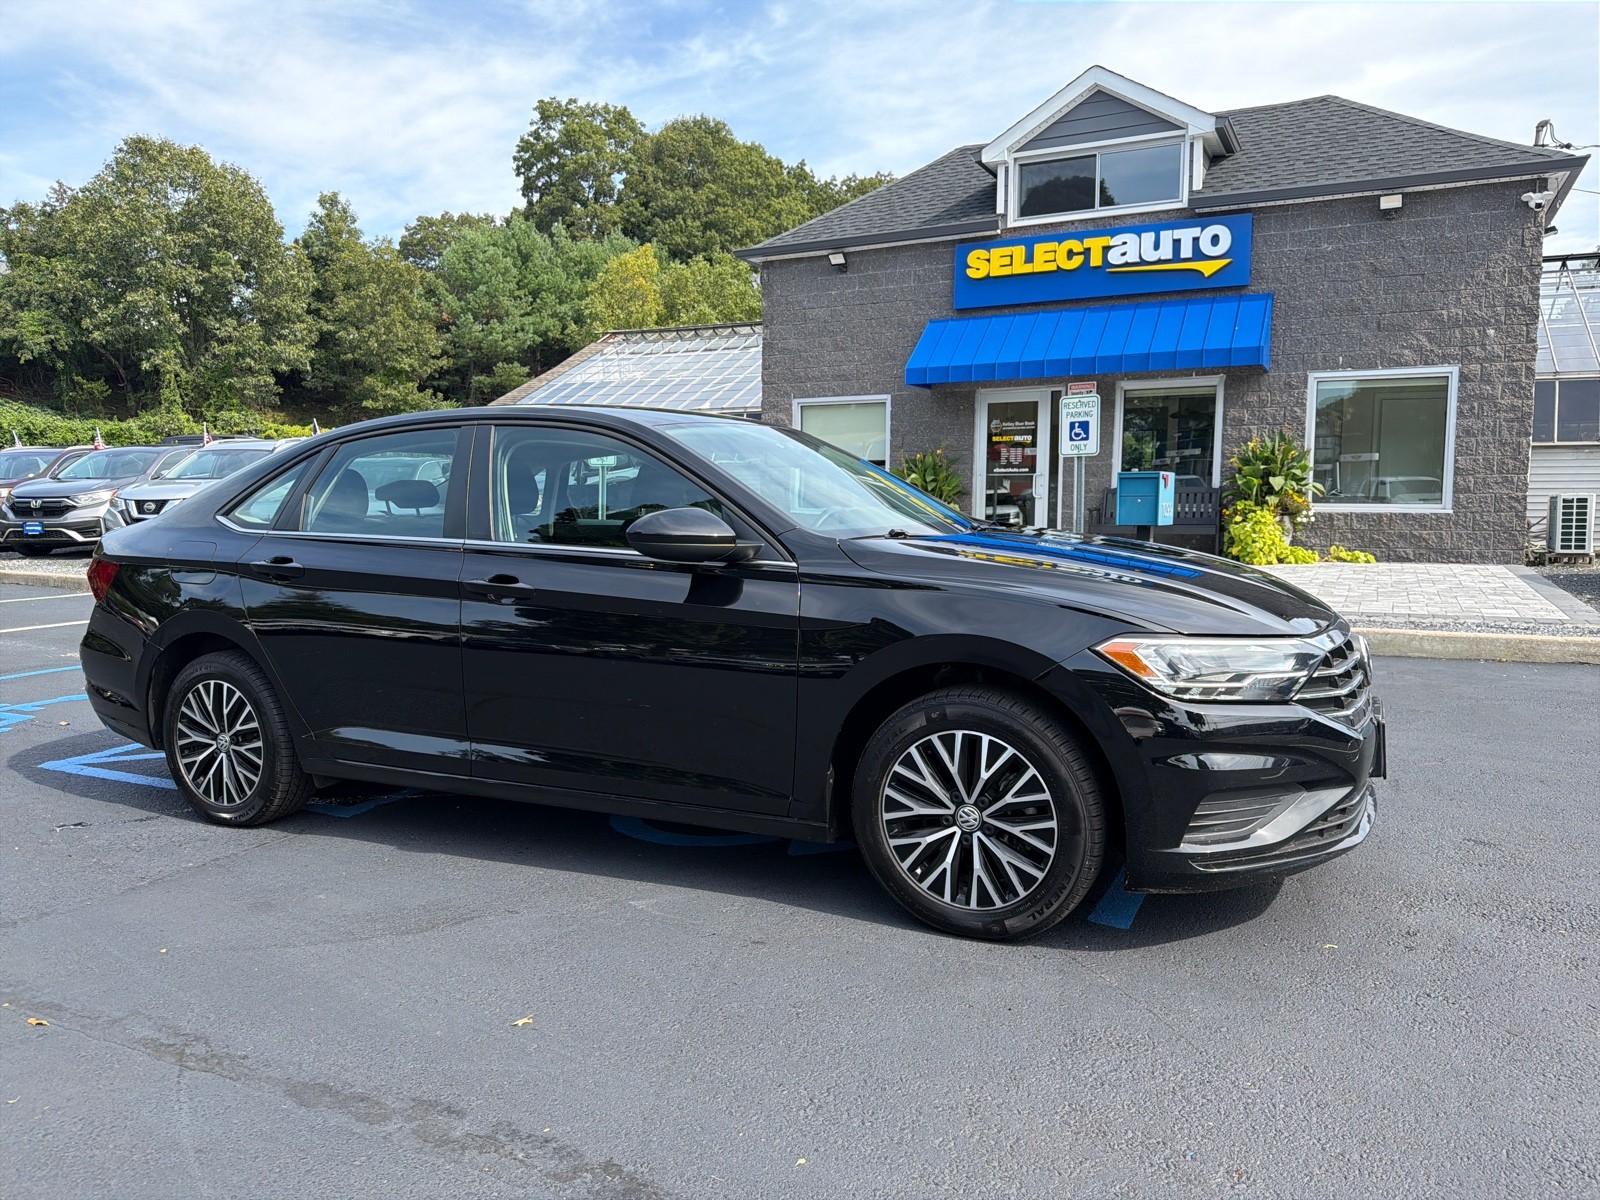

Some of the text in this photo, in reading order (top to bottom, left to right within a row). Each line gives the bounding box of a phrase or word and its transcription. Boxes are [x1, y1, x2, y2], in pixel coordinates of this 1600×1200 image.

[1063, 400, 1097, 410] RESERVED
[1066, 410, 1093, 419] PARKING
[1070, 443, 1088, 452] ONLY
